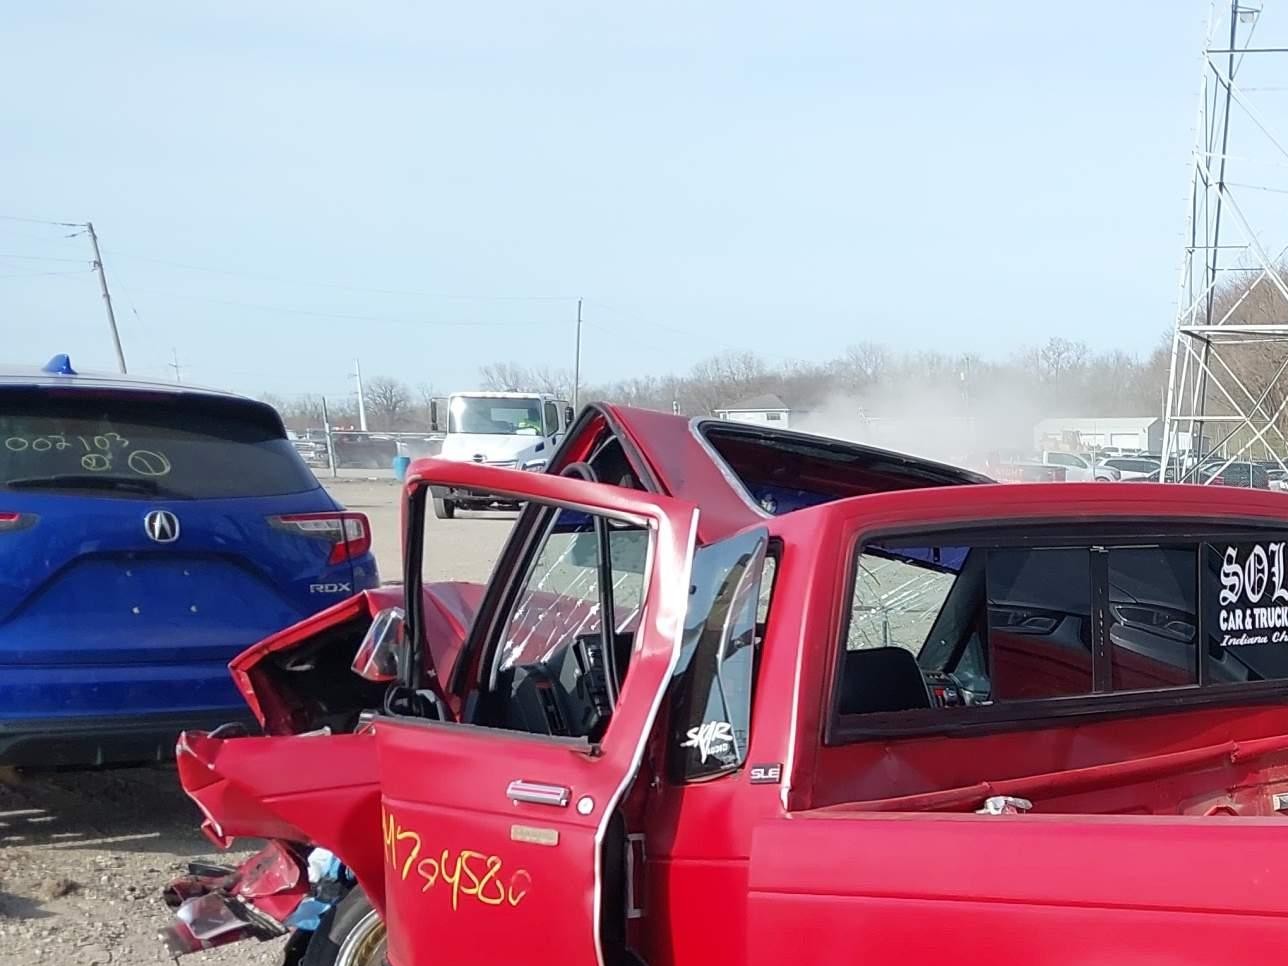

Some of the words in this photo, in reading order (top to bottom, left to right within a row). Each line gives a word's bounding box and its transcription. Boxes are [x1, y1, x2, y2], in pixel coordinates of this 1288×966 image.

[309, 583, 351, 593] RDX
[1219, 608, 1243, 631] CAR
[1245, 609, 1253, 630] &
[1220, 633, 1268, 647] Indiana
[750, 767, 779, 779] SLE
